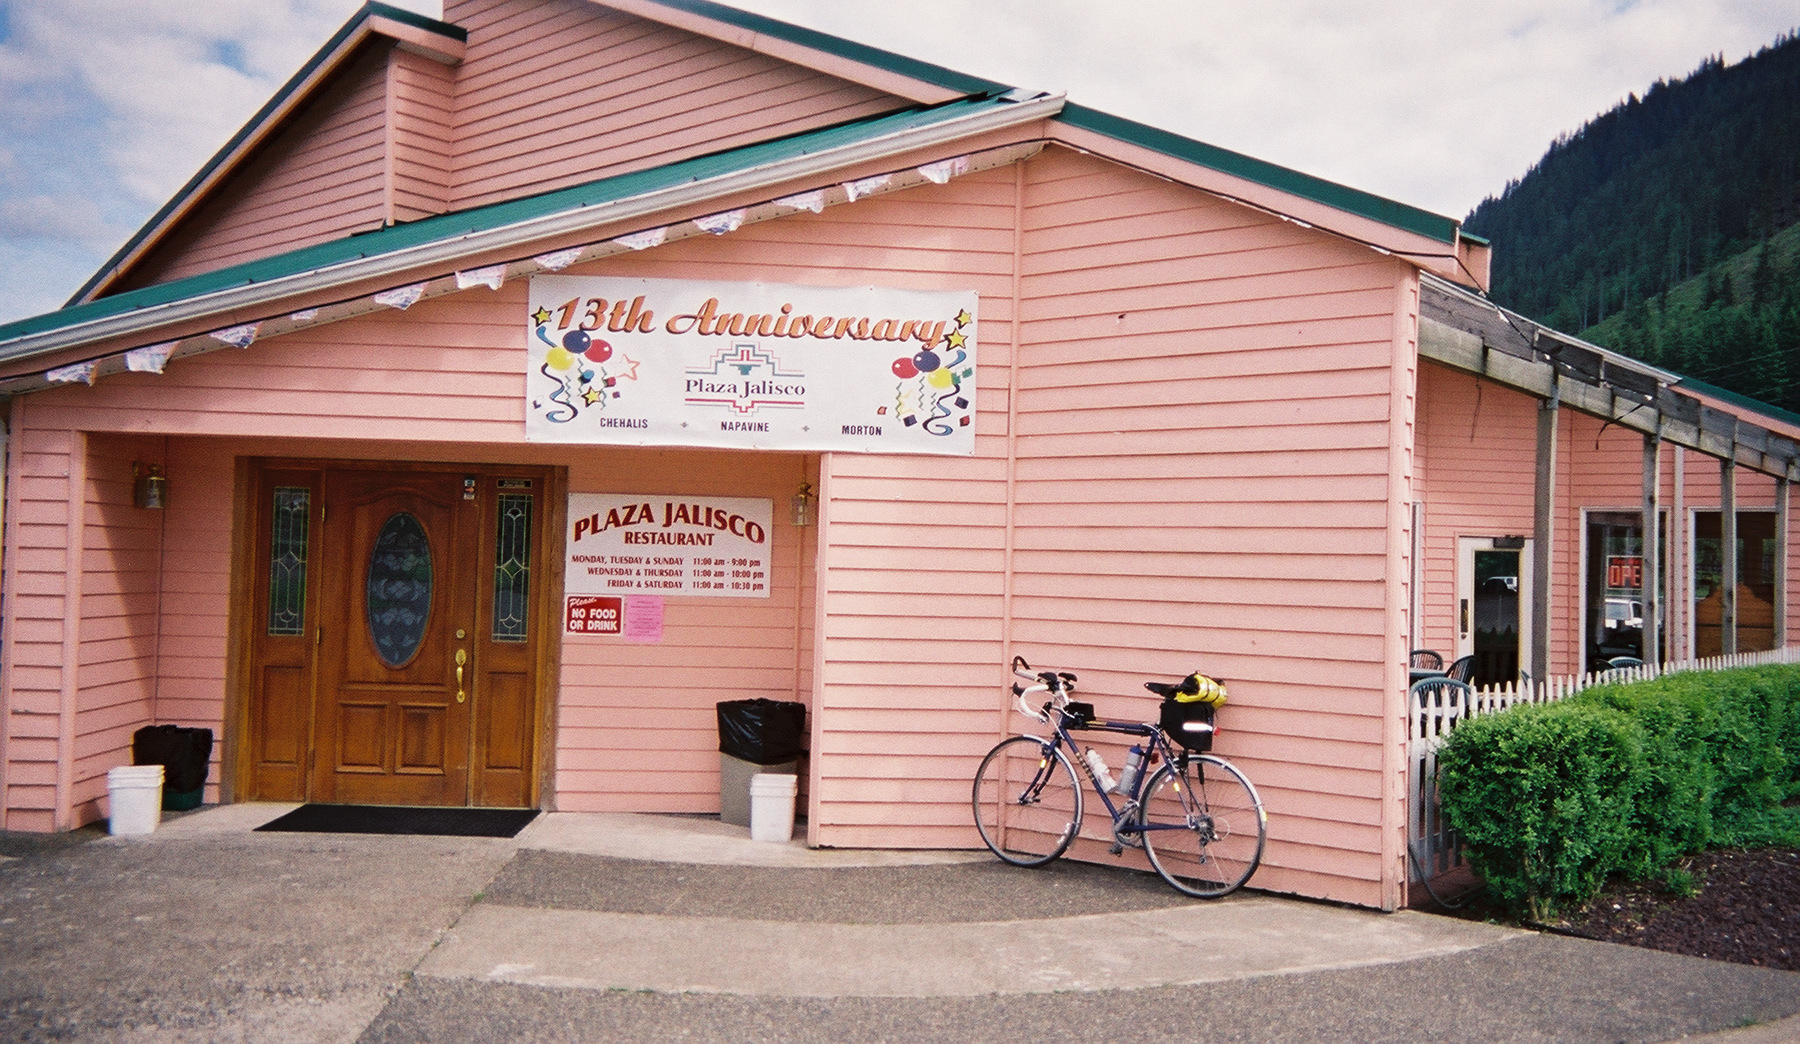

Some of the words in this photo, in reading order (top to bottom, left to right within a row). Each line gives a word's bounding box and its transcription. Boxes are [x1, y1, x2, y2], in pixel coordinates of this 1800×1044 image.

[557, 295, 656, 333] 13th
[665, 297, 947, 351] Anniversary
[685, 379, 738, 395] Plaza
[739, 381, 806, 398] Jalisco
[600, 417, 648, 429] CHEHALIS
[721, 421, 770, 433] NAPAVINE
[841, 425, 882, 436] MORTON
[573, 503, 655, 543] PLAZA
[662, 502, 765, 544] JALISCO
[624, 531, 715, 546] RESTAURANT
[571, 555, 608, 564] MONDAY,
[610, 556, 643, 564] TUESDAY
[645, 557, 651, 565] &
[653, 557, 684, 566] SUNDAY
[731, 558, 747, 566] 9:00
[749, 560, 761, 568] pm
[587, 567, 633, 576] WEDNESDAY
[644, 568, 684, 577] THURSDAY
[693, 569, 712, 577] 11:00
[732, 570, 751, 578] 10:00
[1608, 565, 1642, 587] OPE
[607, 580, 633, 588] FRIDAY
[644, 580, 683, 589] SATURDAY
[692, 581, 711, 589] 11:00
[731, 582, 750, 590] 10:30
[752, 583, 764, 591] pm
[571, 608, 586, 619] NO
[590, 608, 617, 619] FOOD
[569, 620, 584, 630] OR
[587, 620, 618, 631] DRINK
